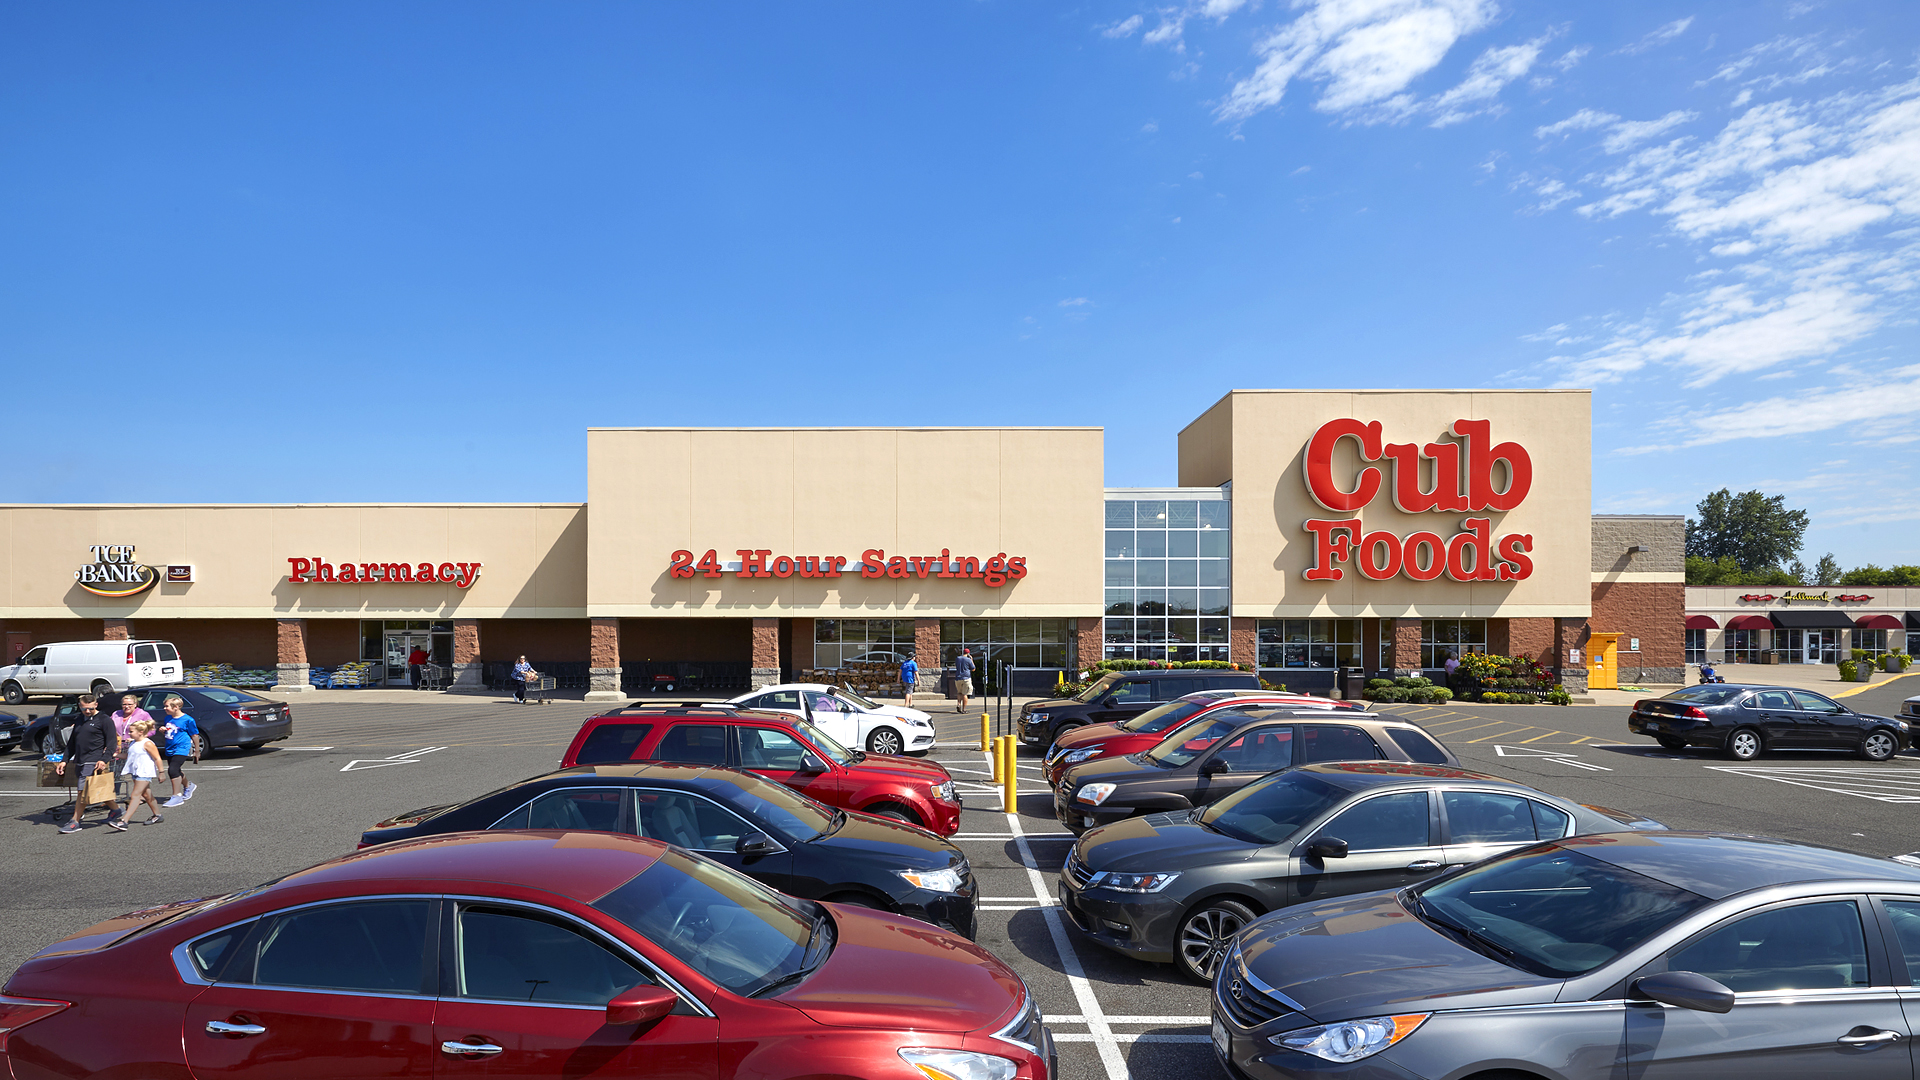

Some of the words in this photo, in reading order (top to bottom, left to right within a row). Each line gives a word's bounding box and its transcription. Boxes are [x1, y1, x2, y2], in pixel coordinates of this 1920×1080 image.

[1303, 418, 1533, 513] Cub
[90, 545, 135, 564] TCF
[1303, 518, 1534, 581] Foods
[80, 564, 144, 583] BANK
[287, 557, 483, 587] Pharmacy
[671, 550, 722, 579] 24
[736, 550, 846, 579] Hour
[861, 548, 1028, 588] Savings
[1782, 590, 1834, 605] Hallmark
